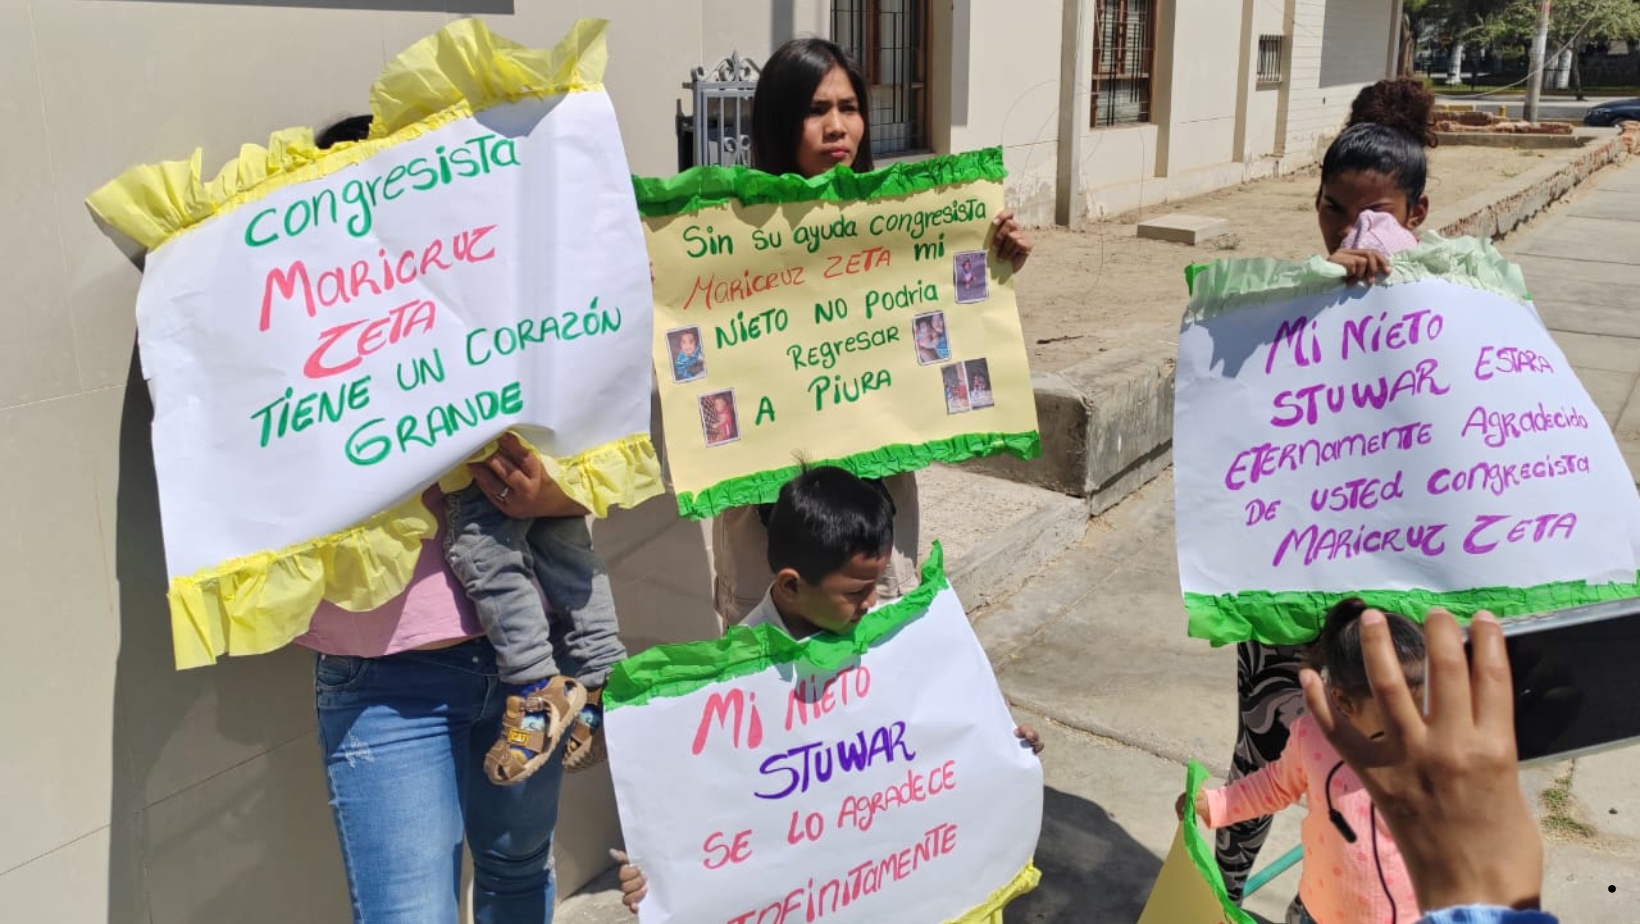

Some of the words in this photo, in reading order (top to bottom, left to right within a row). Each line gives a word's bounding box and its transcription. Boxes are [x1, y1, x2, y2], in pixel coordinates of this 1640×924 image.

[683, 226, 734, 258] Sin
[752, 229, 783, 250] su
[793, 214, 858, 254] ayuda
[823, 247, 891, 279] ZETA
[914, 233, 945, 262] mi
[302, 300, 438, 379] ZETA
[815, 299, 848, 324] NO
[396, 347, 445, 392] UN
[466, 296, 621, 366] CORAZÓN
[1265, 315, 1322, 375] Mi
[755, 396, 776, 426] A
[1270, 358, 1450, 428] STUWAR
[1474, 345, 1555, 381] ESTARA
[344, 381, 524, 466] GRANDE
[1244, 498, 1281, 527] DE
[1462, 513, 1577, 555] ZETA
[691, 688, 763, 755] Mi
[754, 721, 916, 800] STUWAR
[702, 829, 753, 870] SE
[787, 811, 824, 845] LO
